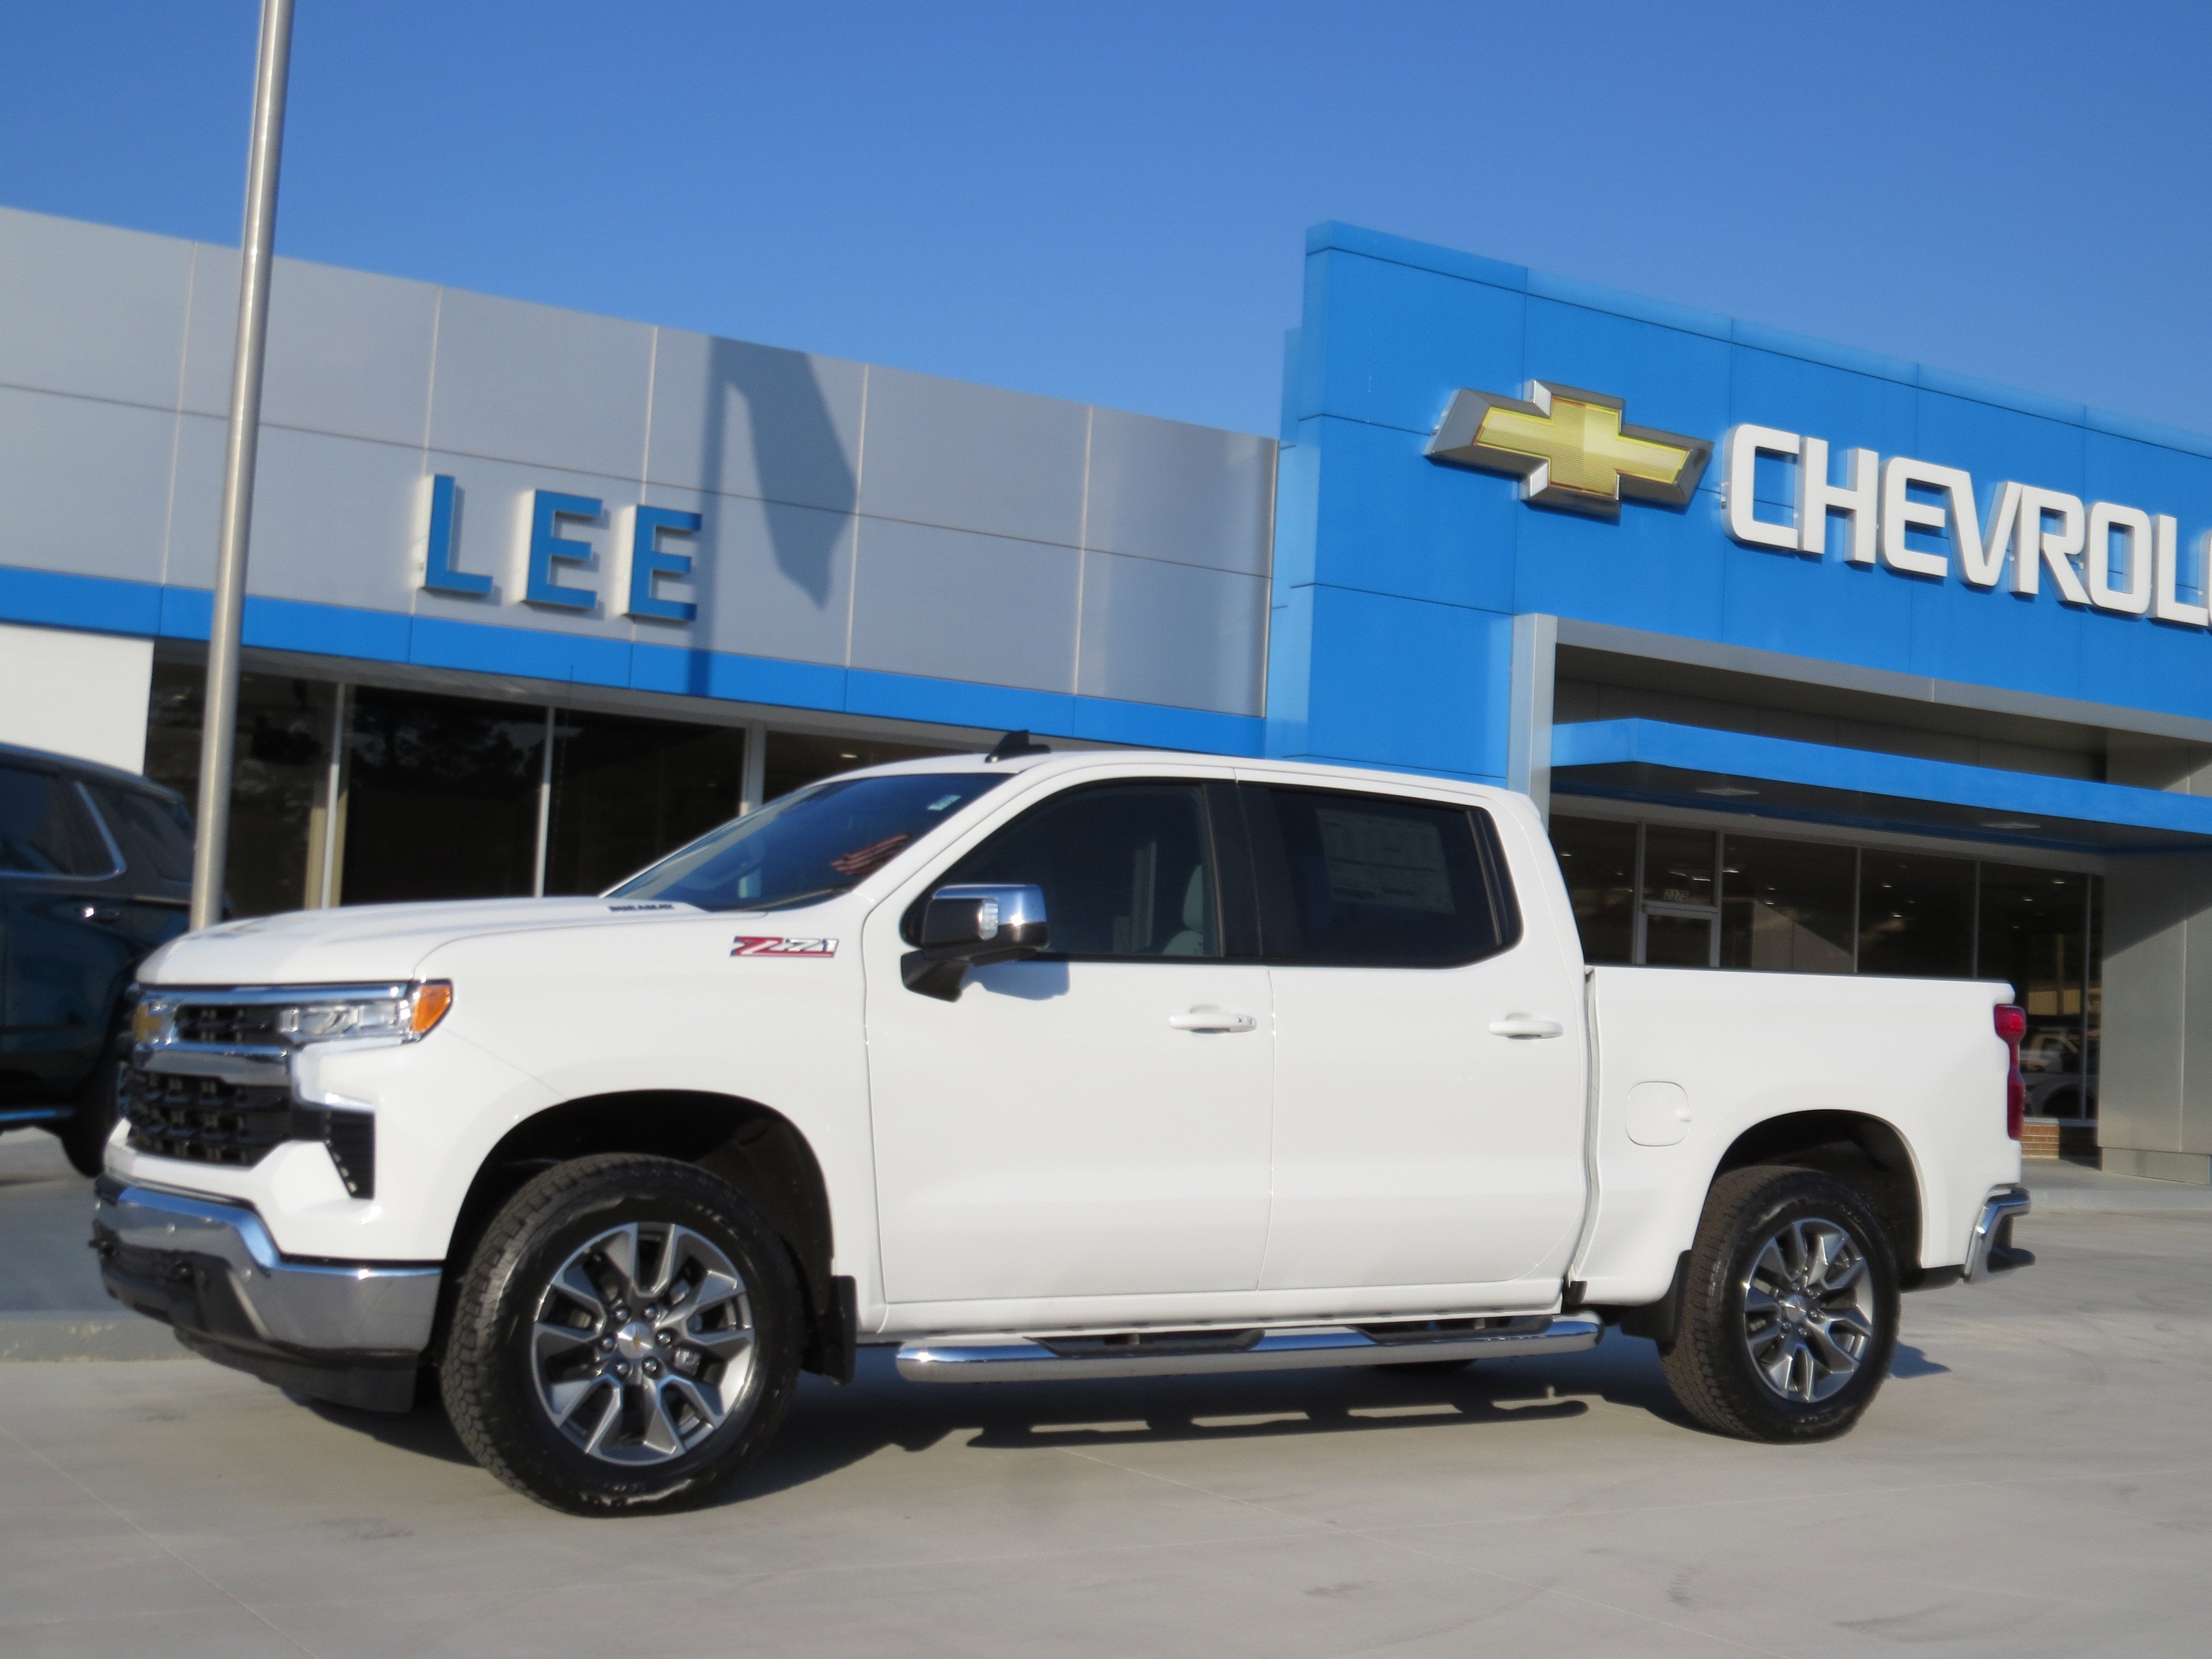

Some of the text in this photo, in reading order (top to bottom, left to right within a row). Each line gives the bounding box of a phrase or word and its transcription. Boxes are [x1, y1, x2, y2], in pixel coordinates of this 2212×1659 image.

[421, 473, 703, 622] LEE
[1722, 424, 2212, 627] CHEVROL
[730, 936, 839, 957] Z71
